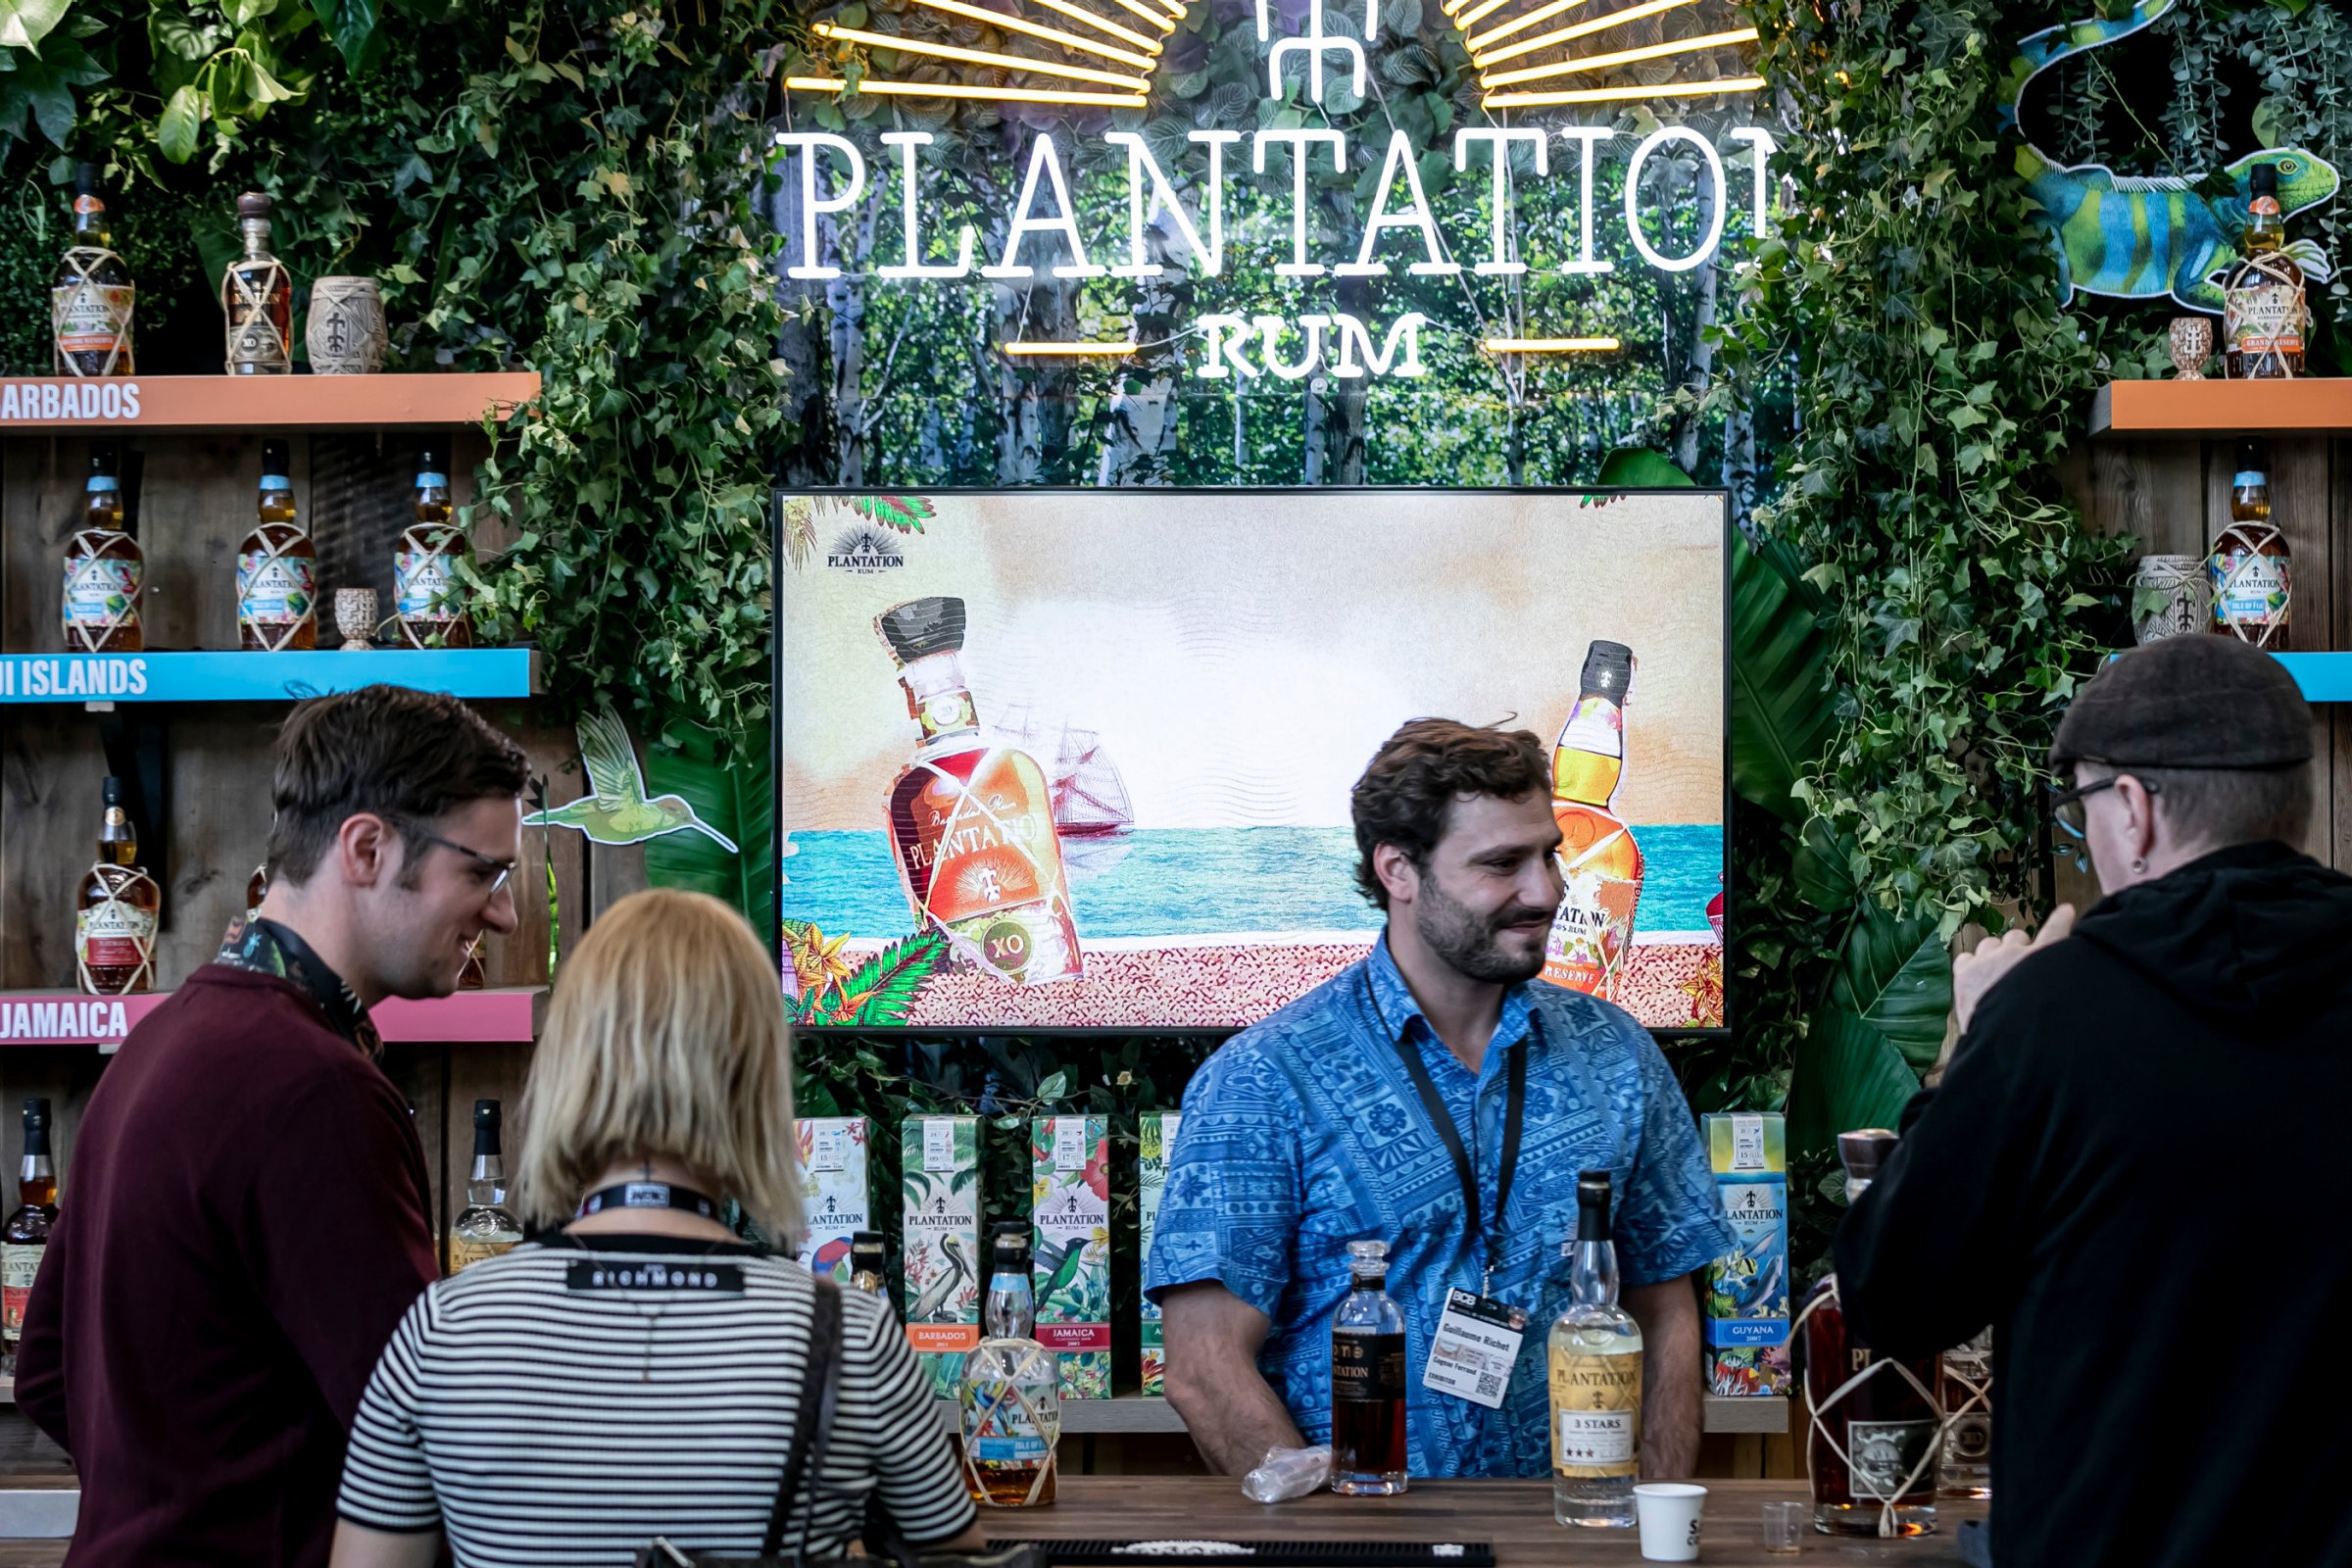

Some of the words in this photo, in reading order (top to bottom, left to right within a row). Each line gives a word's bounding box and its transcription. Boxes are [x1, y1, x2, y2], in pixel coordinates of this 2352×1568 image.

[1197, 313, 1427, 379] RUM
[827, 556, 904, 567] PLANTATION
[22, 659, 147, 695] ISLANDS
[1568, 926, 1587, 936] RUM
[991, 934, 1024, 958] XO
[0, 1002, 128, 1039] JAMAICA
[808, 1214, 863, 1225] LANTATION
[1040, 1214, 1104, 1225] PLANTATION
[1725, 1208, 1784, 1220] LANTATION
[908, 1215, 972, 1226] PLANTATION
[592, 1270, 717, 1288] RICHMOND
[1451, 1290, 1476, 1306] BCB
[918, 1332, 966, 1341] BARBADOS
[1053, 1328, 1095, 1337] JAMAICA
[1732, 1326, 1775, 1335] GUYANA
[1443, 1323, 1482, 1343] Guillaume
[1483, 1335, 1511, 1352] Richet
[1574, 1418, 1582, 1429] 3
[1584, 1418, 1622, 1430] STARS
